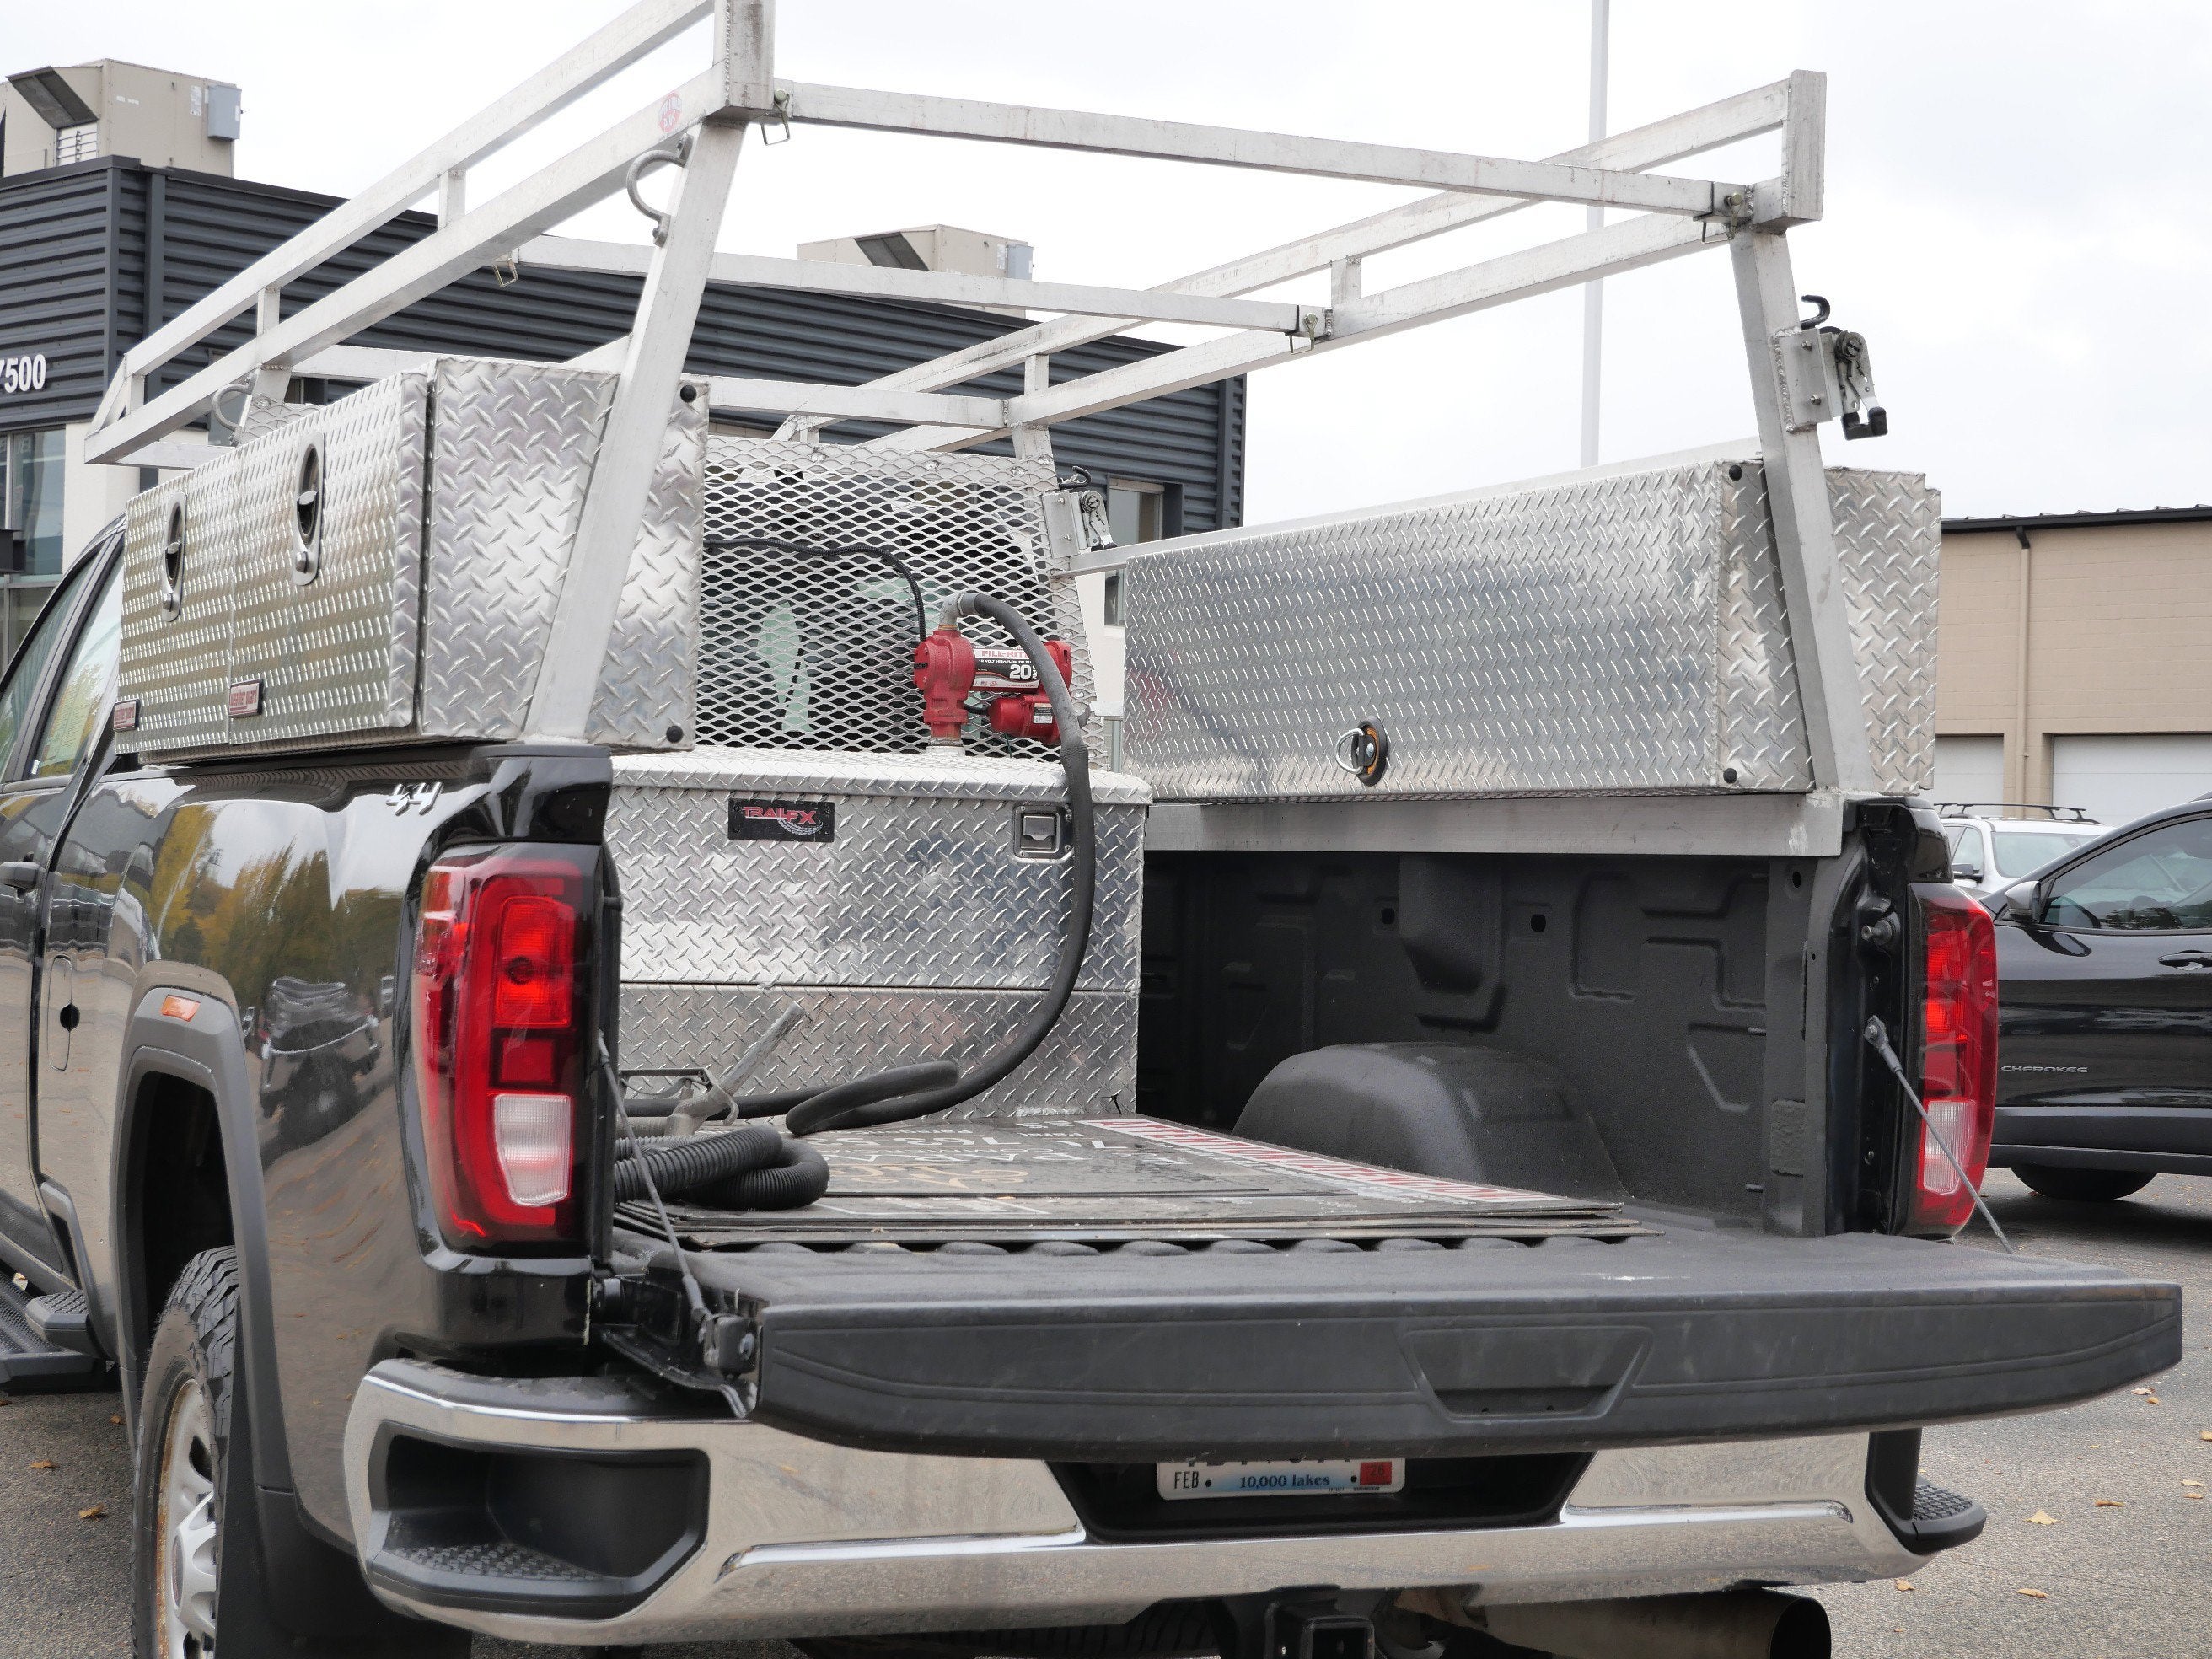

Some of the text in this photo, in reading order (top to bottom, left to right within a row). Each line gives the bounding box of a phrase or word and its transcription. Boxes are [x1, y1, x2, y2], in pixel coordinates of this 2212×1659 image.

[1010, 664, 1031, 679] 20
[1173, 1471, 1199, 1489] FEB
[1239, 1474, 1330, 1489] 10,000 lakes
